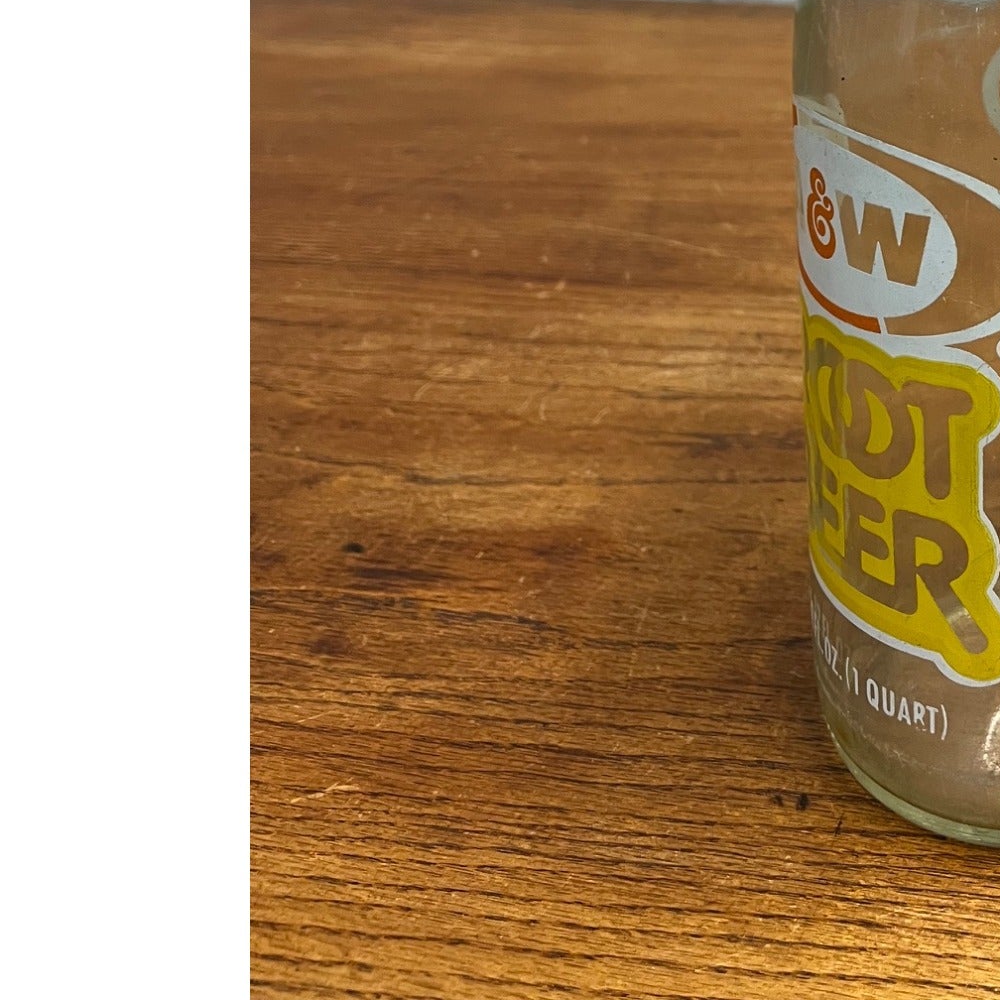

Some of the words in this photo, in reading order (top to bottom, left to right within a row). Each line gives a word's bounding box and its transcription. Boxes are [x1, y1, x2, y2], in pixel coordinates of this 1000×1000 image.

[799, 166, 932, 288] &W
[812, 462, 989, 655] EER
[845, 656, 859, 696] (1
[866, 678, 948, 741] QUART)
